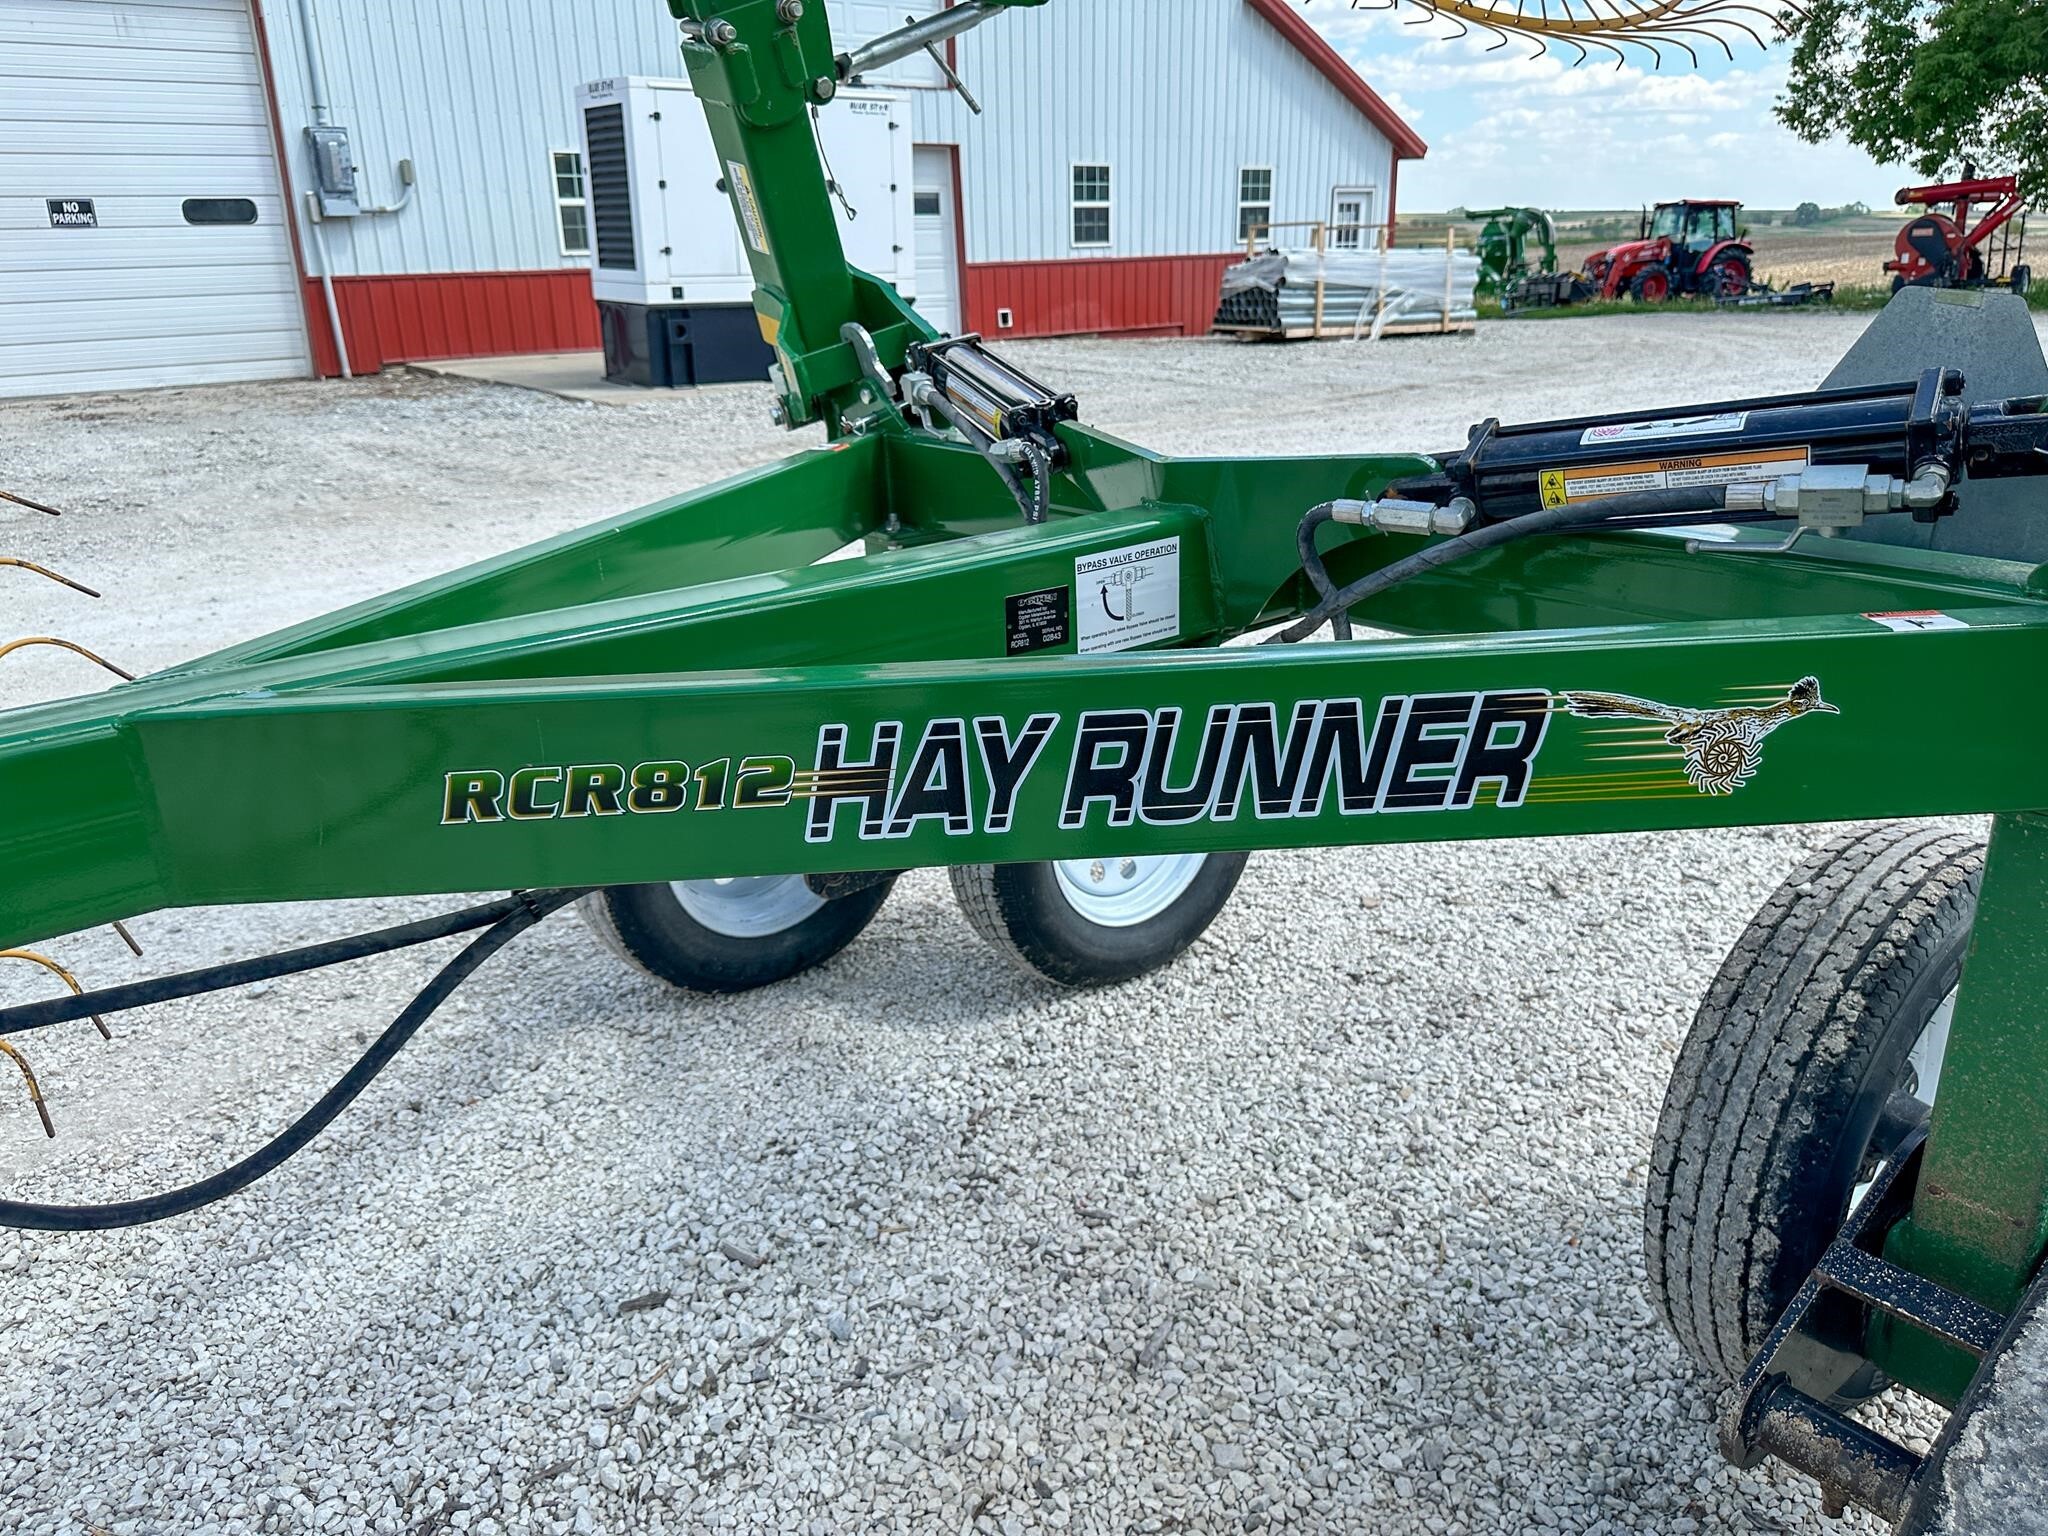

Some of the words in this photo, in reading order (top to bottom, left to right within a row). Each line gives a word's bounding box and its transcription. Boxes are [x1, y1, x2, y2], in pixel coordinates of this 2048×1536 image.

[62, 202, 80, 213] NO
[52, 212, 94, 224] PARKING
[1659, 458, 1702, 470] WARNING
[1076, 558, 1106, 572] BYPASS
[1109, 552, 1132, 564] VALVE
[1134, 543, 1176, 559] OPERATION
[1042, 631, 1061, 642] 02843
[439, 755, 798, 825] RCR812
[804, 711, 1061, 843] HAY
[1057, 688, 1552, 829] RUNNER
